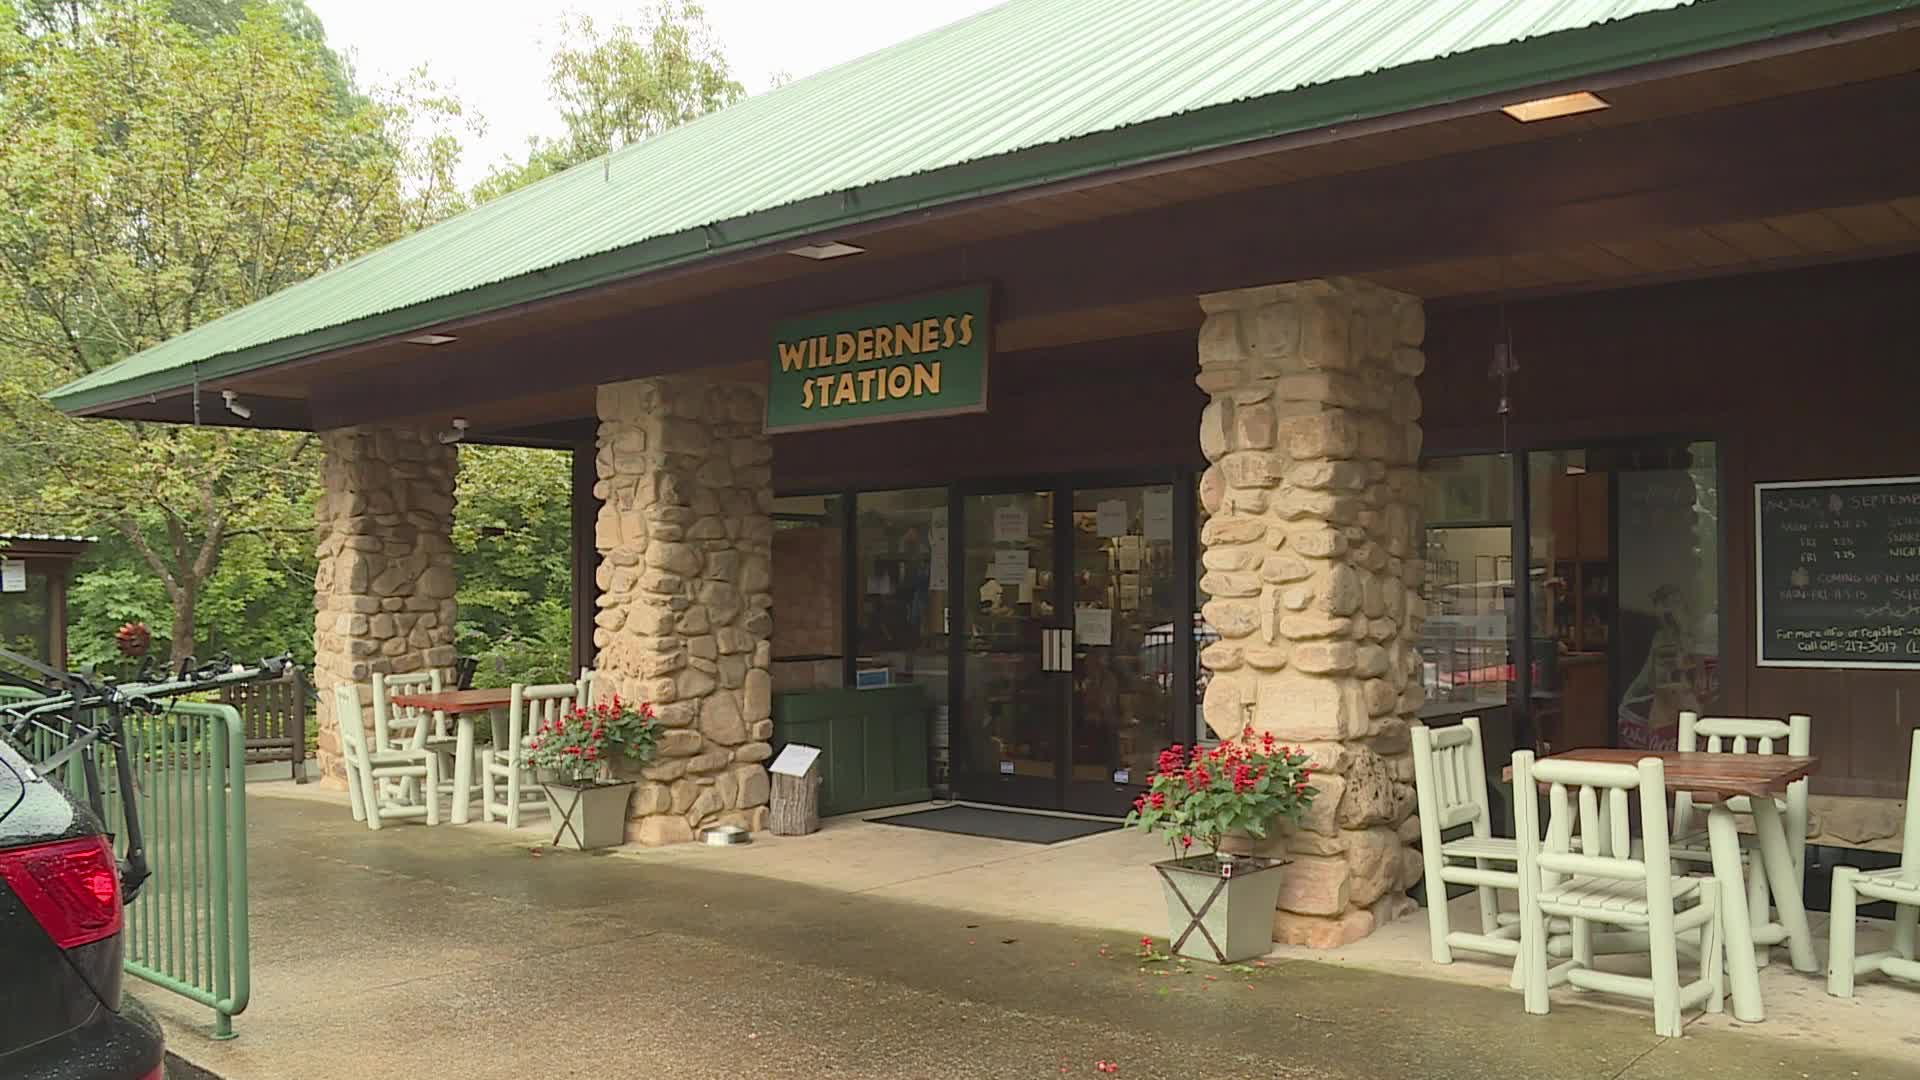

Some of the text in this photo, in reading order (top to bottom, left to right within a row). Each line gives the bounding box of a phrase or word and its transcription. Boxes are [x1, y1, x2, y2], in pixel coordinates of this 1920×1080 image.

[778, 313, 974, 371] WILDERNESS
[801, 361, 942, 408] STATION
[1817, 572, 1861, 585] COMING
[1794, 629, 1822, 639] more
[1824, 626, 1844, 637] info
[1861, 625, 1905, 641] register
[1797, 640, 1818, 652] Call
[1819, 640, 1897, 654] 615-217-3017
